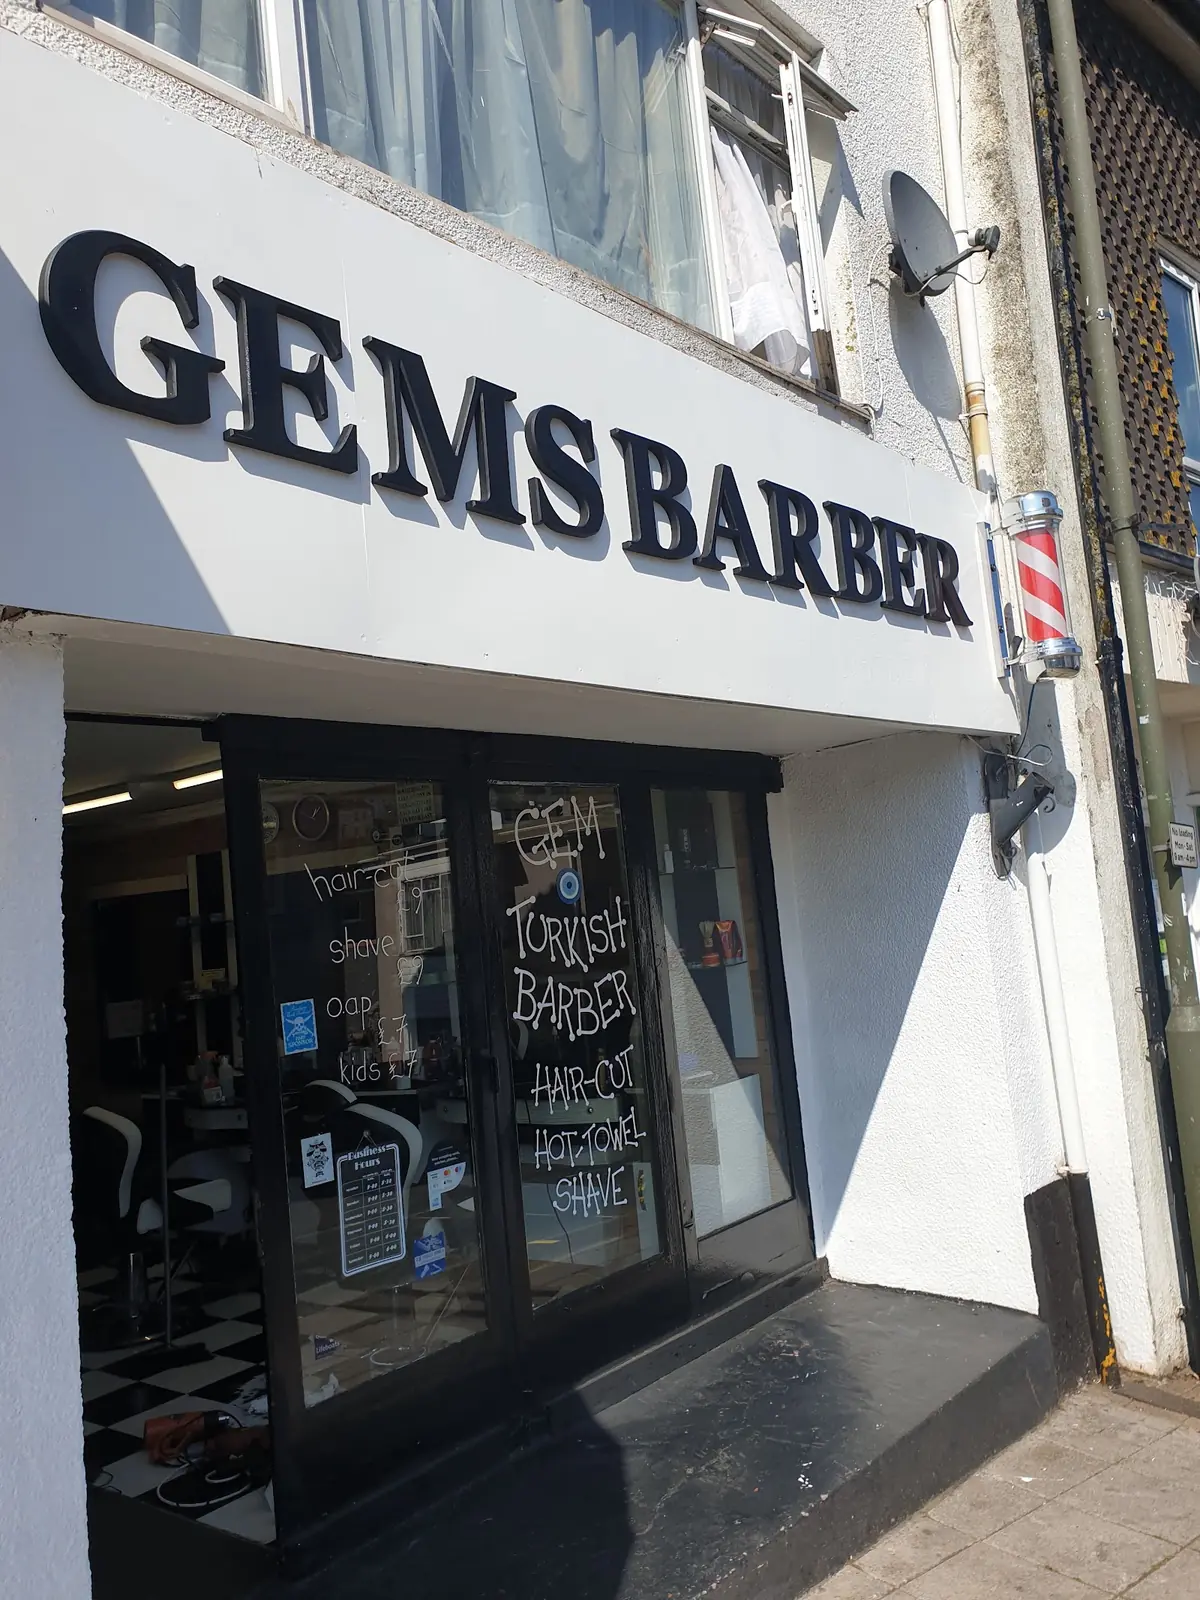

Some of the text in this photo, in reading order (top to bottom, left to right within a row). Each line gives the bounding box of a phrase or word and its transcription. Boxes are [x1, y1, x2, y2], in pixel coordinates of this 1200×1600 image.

[514, 796, 606, 869] GEM
[304, 851, 415, 901] hair-cut
[329, 926, 395, 964] shave
[506, 896, 627, 972] TURKISH
[513, 967, 637, 1041] BARBER
[339, 1049, 418, 1085] kids £7
[531, 1044, 634, 1114] HAIR-CUT
[347, 1144, 386, 1160] Business
[354, 1158, 381, 1171] Hours
[553, 1166, 628, 1217] SHAVE
